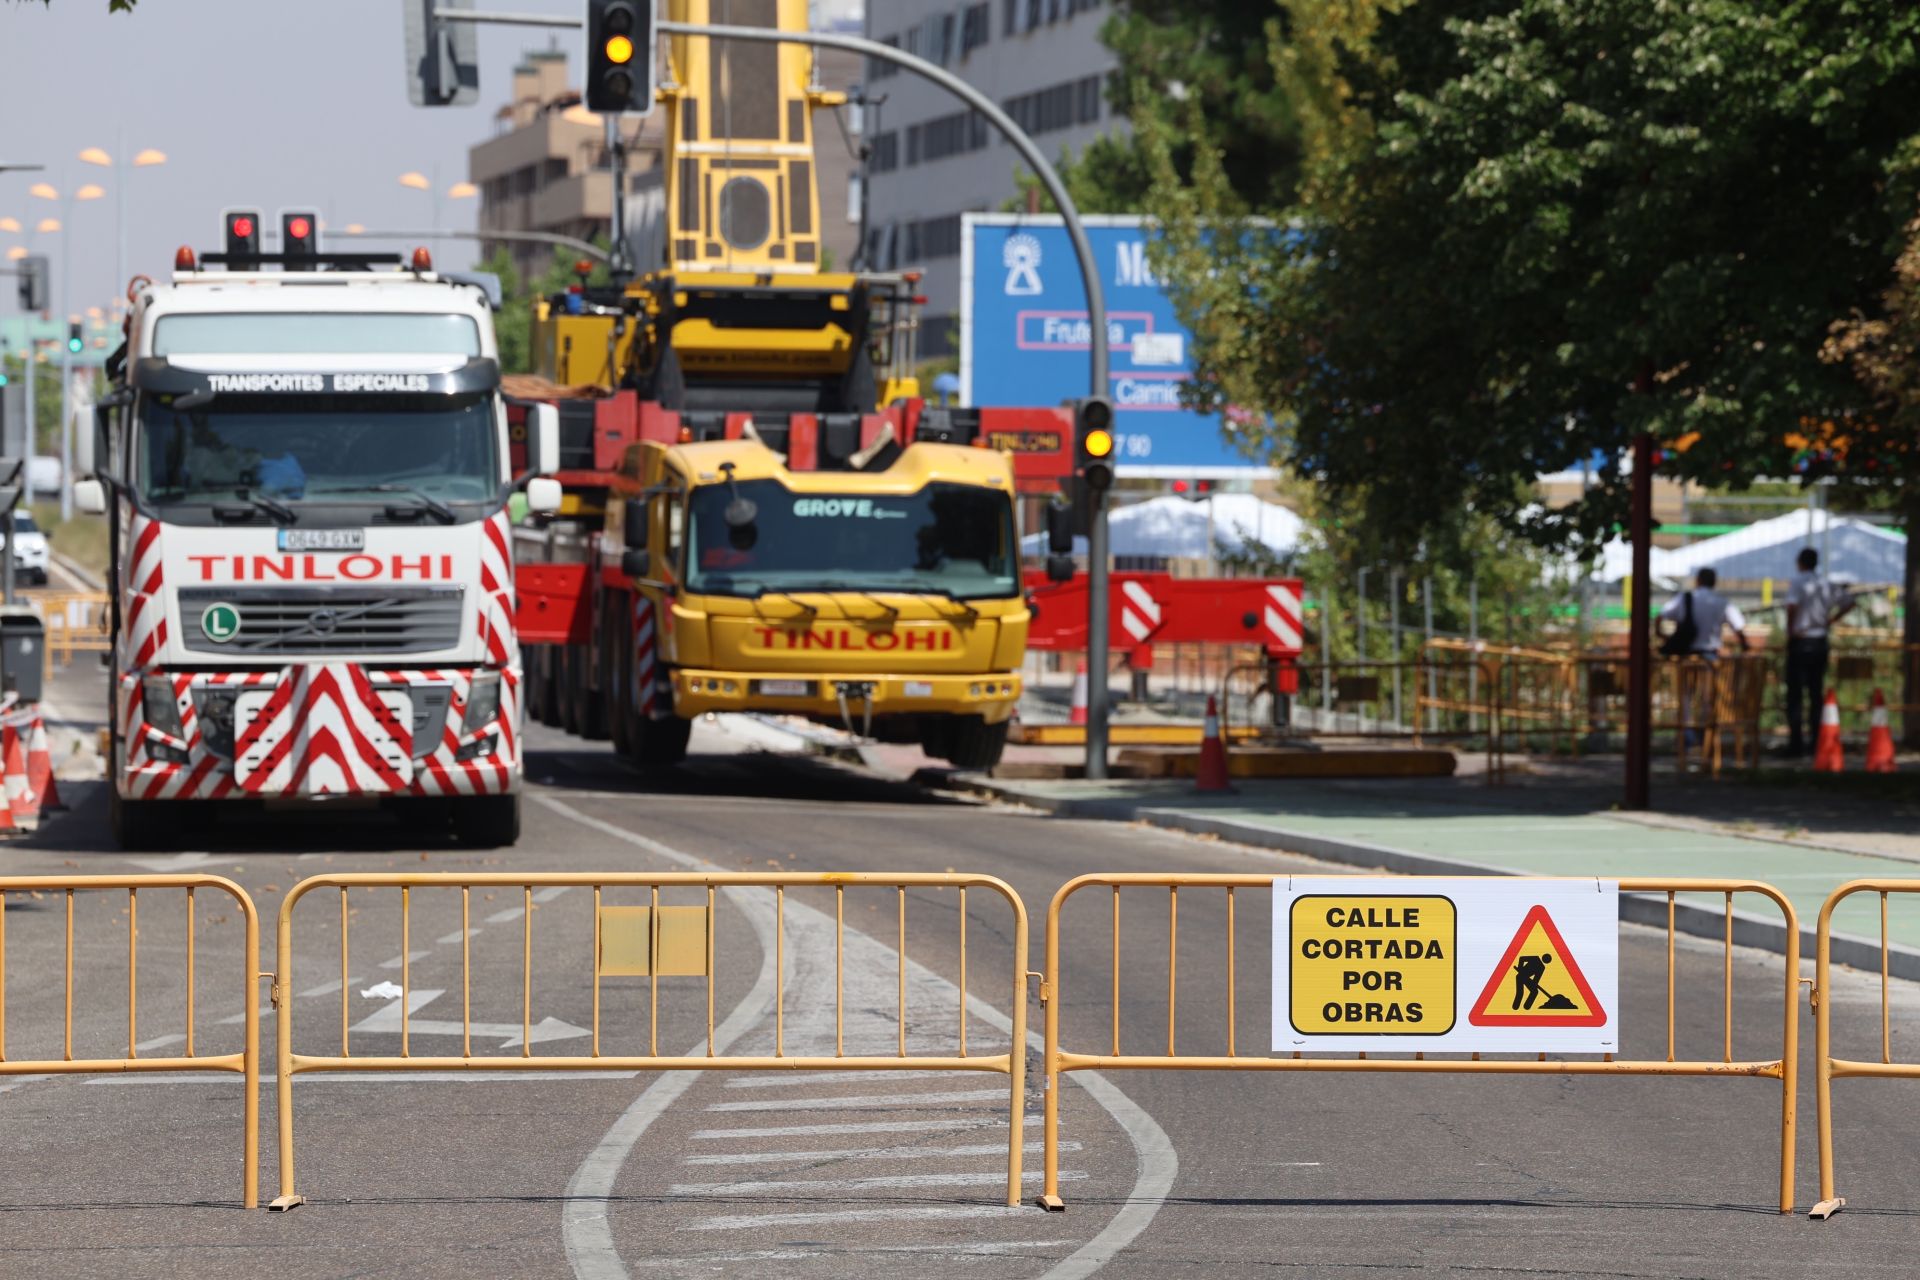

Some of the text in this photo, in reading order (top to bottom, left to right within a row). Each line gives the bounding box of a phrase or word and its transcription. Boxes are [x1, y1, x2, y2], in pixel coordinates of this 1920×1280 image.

[208, 375, 429, 391] TRANSPORTES ESPECIALES
[793, 499, 874, 517] GROVE
[187, 555, 453, 581] TINLOHI
[212, 610, 230, 635] L
[754, 628, 952, 651] TINLOHI
[1325, 907, 1420, 928] CALLE
[1301, 939, 1444, 959] CORTADA
[1343, 971, 1403, 991] POR
[1322, 1002, 1423, 1023] OBRAS
